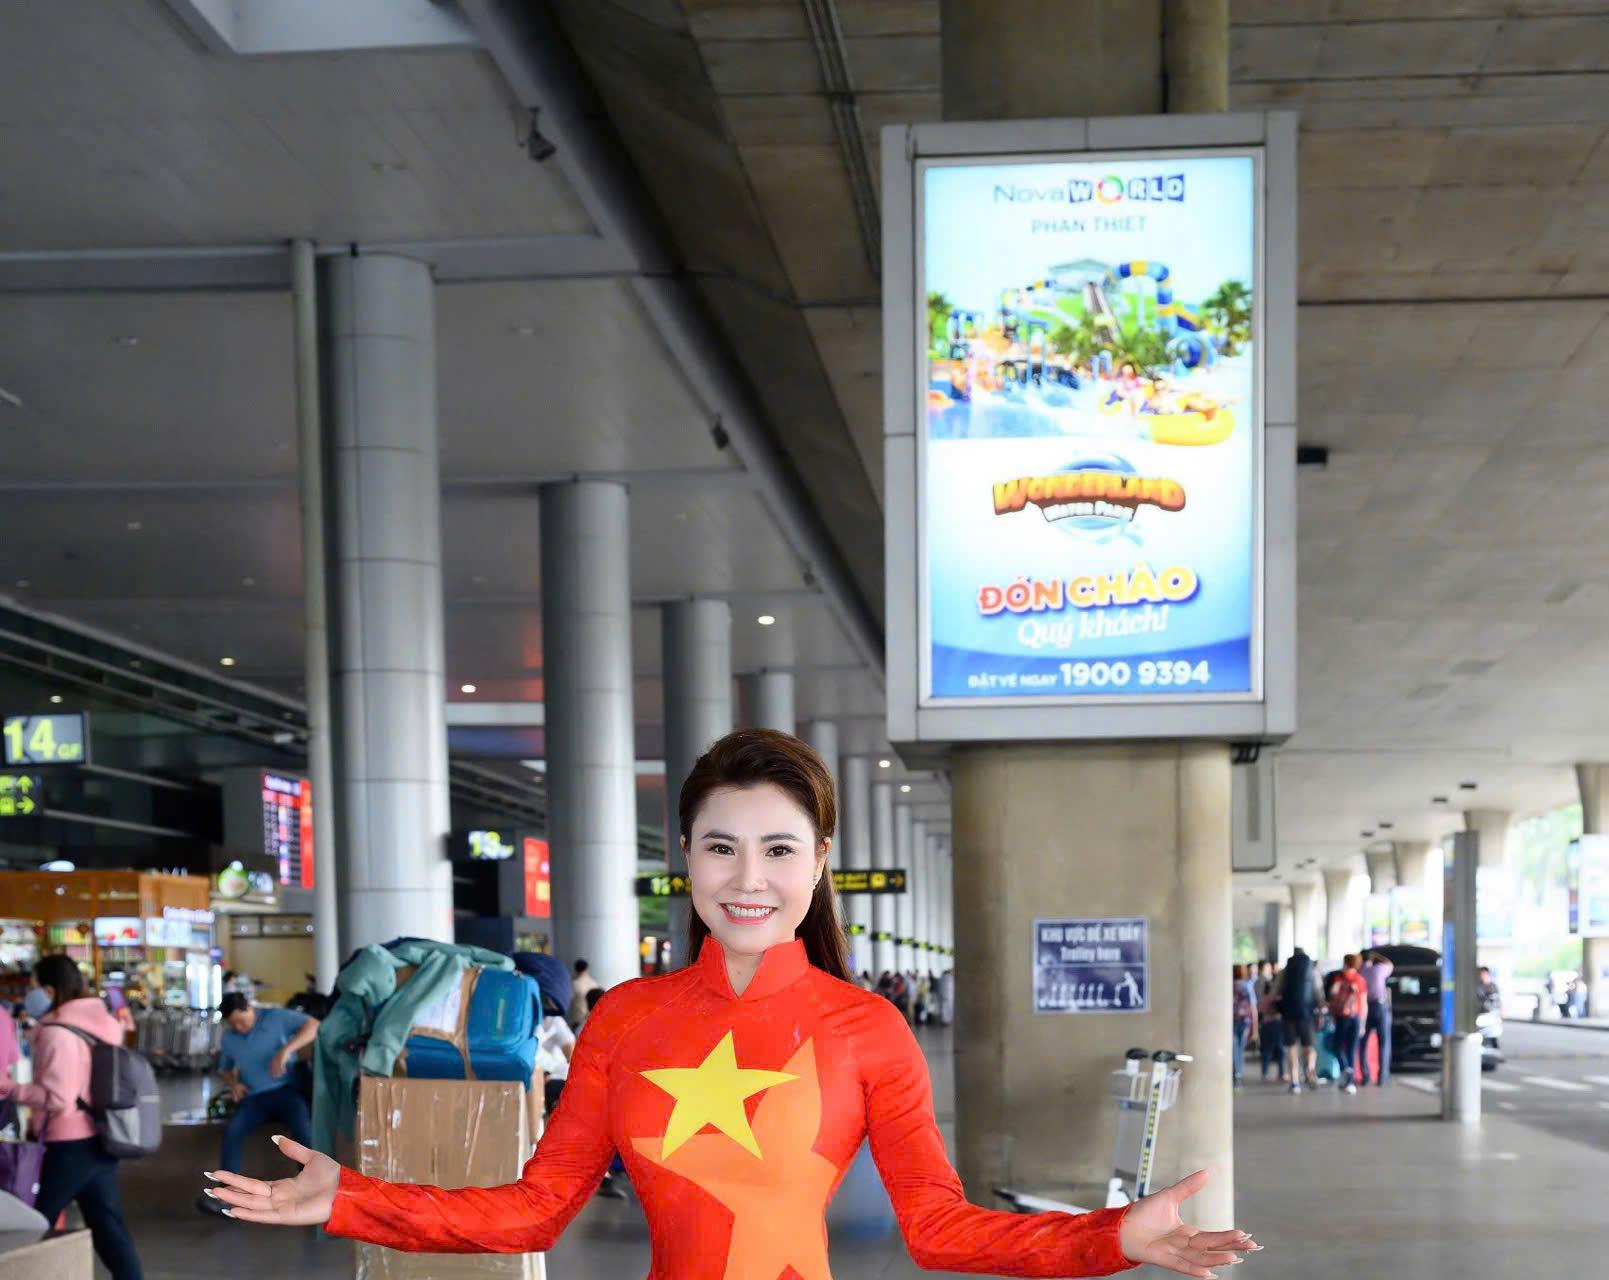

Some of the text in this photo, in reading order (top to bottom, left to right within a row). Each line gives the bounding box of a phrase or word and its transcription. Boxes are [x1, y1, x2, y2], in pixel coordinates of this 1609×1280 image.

[978, 562, 1198, 614] ĐÓN CHÀO
[1017, 617, 1073, 649] Quý
[1060, 662, 1130, 687] 1900
[1138, 660, 1210, 686] 9394
[4, 718, 55, 760] 14
